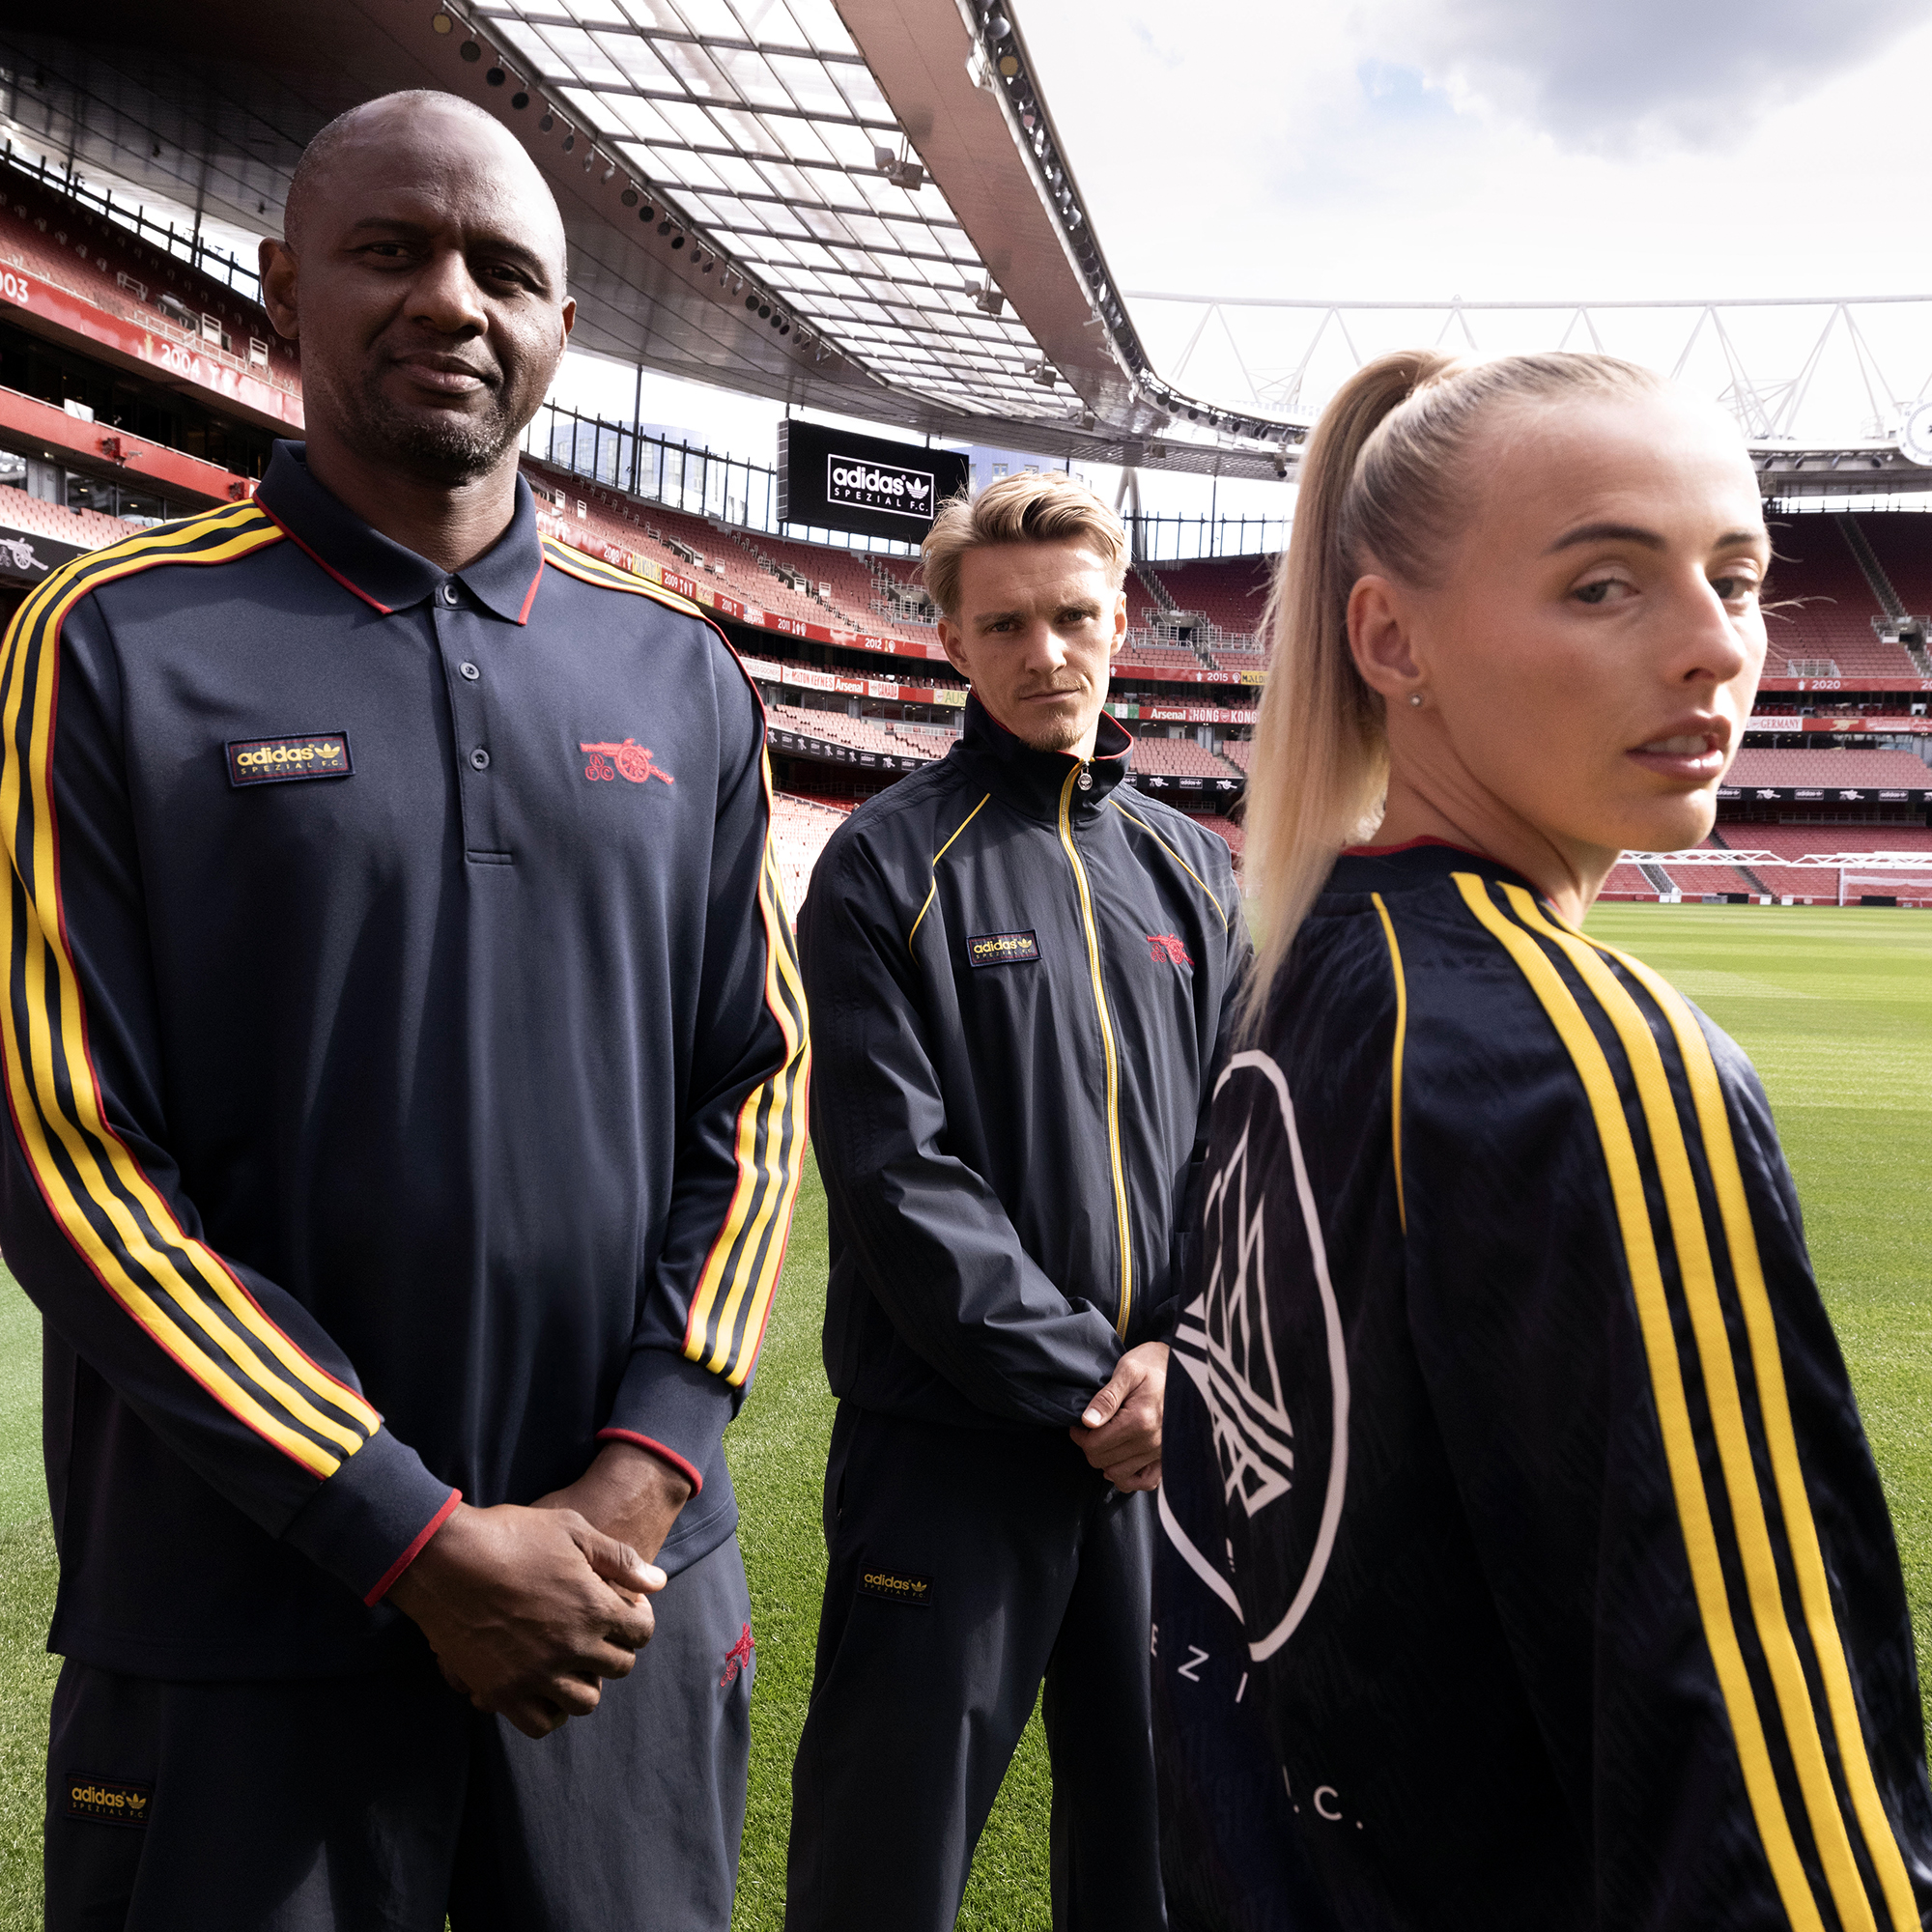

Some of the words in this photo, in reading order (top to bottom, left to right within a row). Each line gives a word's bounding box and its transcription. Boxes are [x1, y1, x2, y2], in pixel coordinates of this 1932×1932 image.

[160, 343, 201, 378] 2004
[833, 466, 905, 496] adidas
[834, 487, 901, 507] SPEZIAL
[910, 501, 928, 512] F.C.
[604, 545, 620, 563] 2008
[665, 572, 678, 588] 2009
[778, 618, 790, 631] 2011
[865, 638, 882, 649] 2012
[810, 672, 833, 689] KEYNES
[1208, 672, 1229, 682] 2015
[836, 677, 864, 694] Arsenal
[1811, 680, 1841, 690] 2020
[1151, 708, 1186, 721] Arsenal
[1193, 709, 1219, 722] HONG
[1231, 710, 1257, 724] KONG
[1760, 718, 1800, 729] GERMANY
[237, 745, 315, 767] adidas
[241, 762, 313, 775] SPEZIAL
[974, 939, 1018, 953] adidas
[976, 950, 1017, 959] SPEZIAL
[864, 1574, 910, 1591] adidas
[864, 1582, 907, 1597] SPEZIAL
[71, 1786, 125, 1807] adidas
[72, 1802, 123, 1816] SPEZIAL
